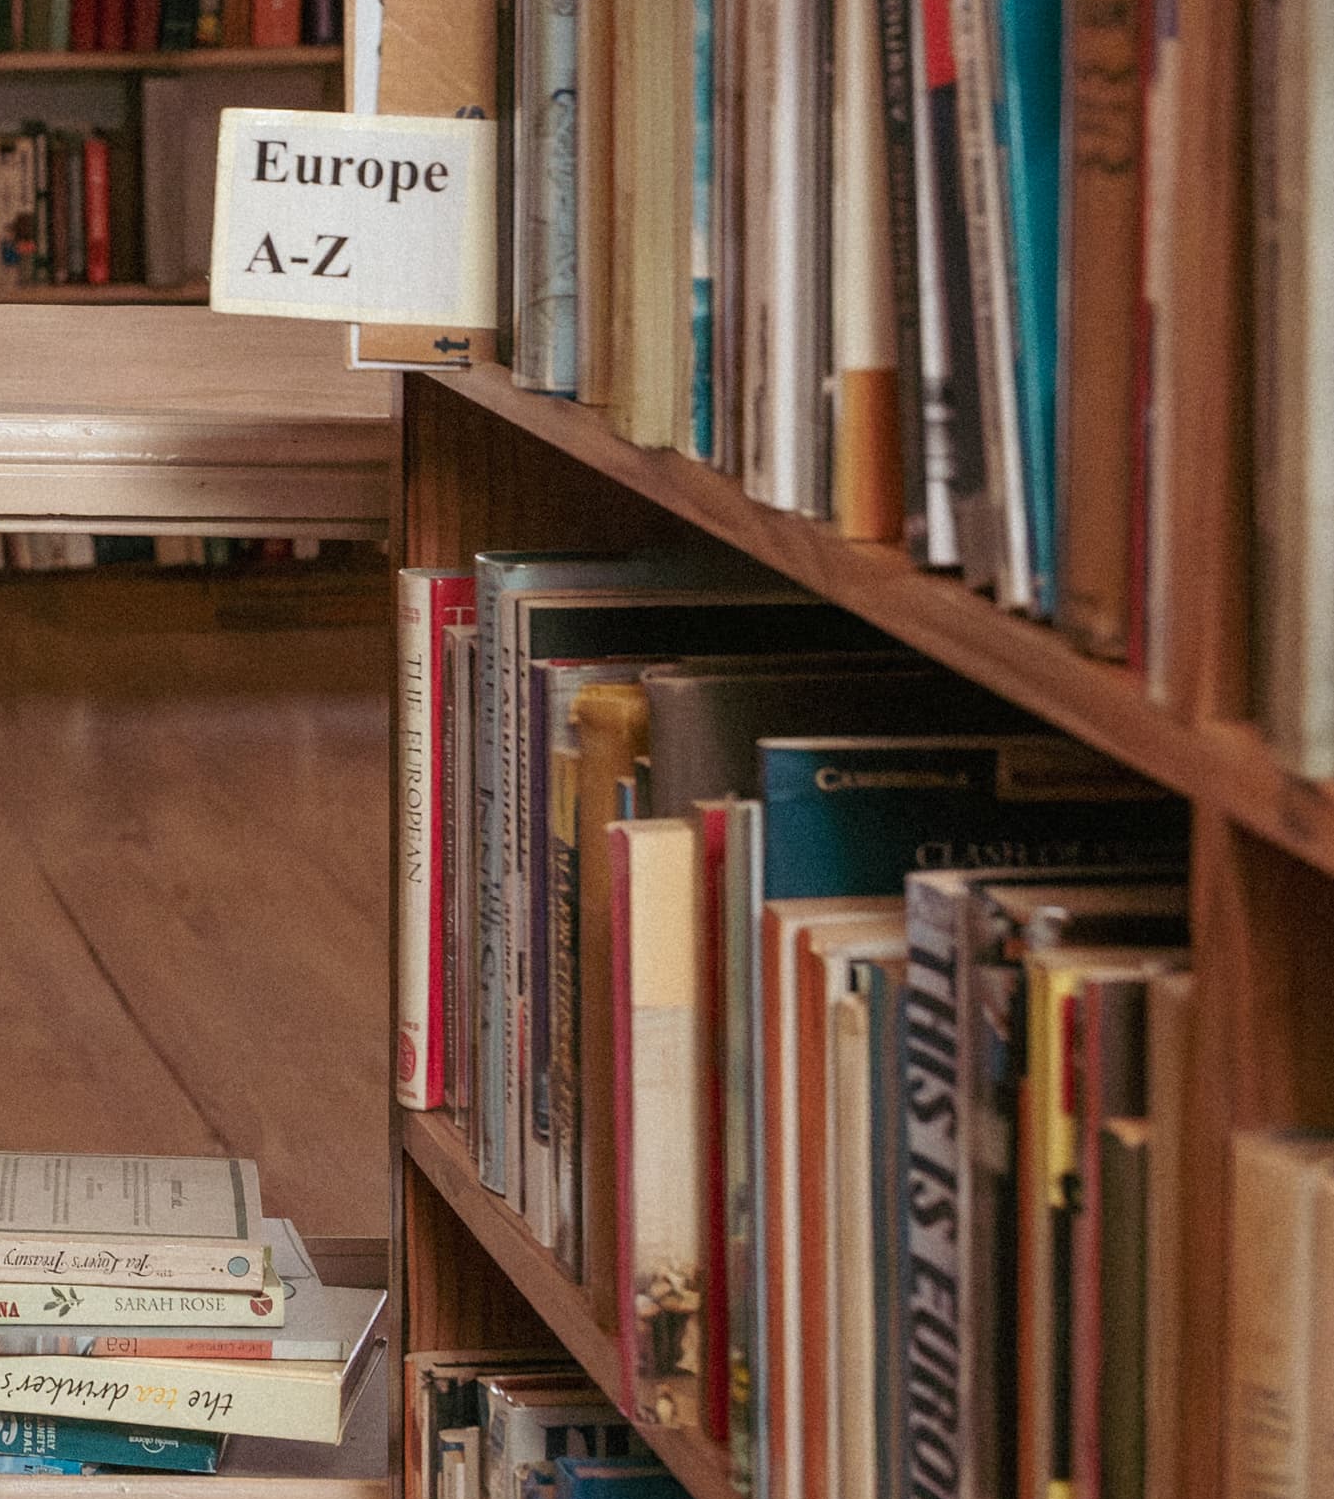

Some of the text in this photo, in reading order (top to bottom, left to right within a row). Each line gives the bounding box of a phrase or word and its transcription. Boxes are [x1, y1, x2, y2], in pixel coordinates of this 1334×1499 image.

[252, 139, 450, 204] Europe
[244, 232, 352, 279] A-Z
[405, 653, 424, 884] THE EUROPEAN
[906, 944, 959, 1133] THIS
[908, 1158, 959, 1239] IS
[2, 1248, 66, 1275] Treasury
[123, 1253, 155, 1278] Tea
[114, 1297, 227, 1313] SARAH ROSE
[105, 1335, 139, 1356] tea
[0, 1371, 131, 1412] drinker's
[132, 1383, 178, 1411] tea
[187, 1388, 234, 1421] the
